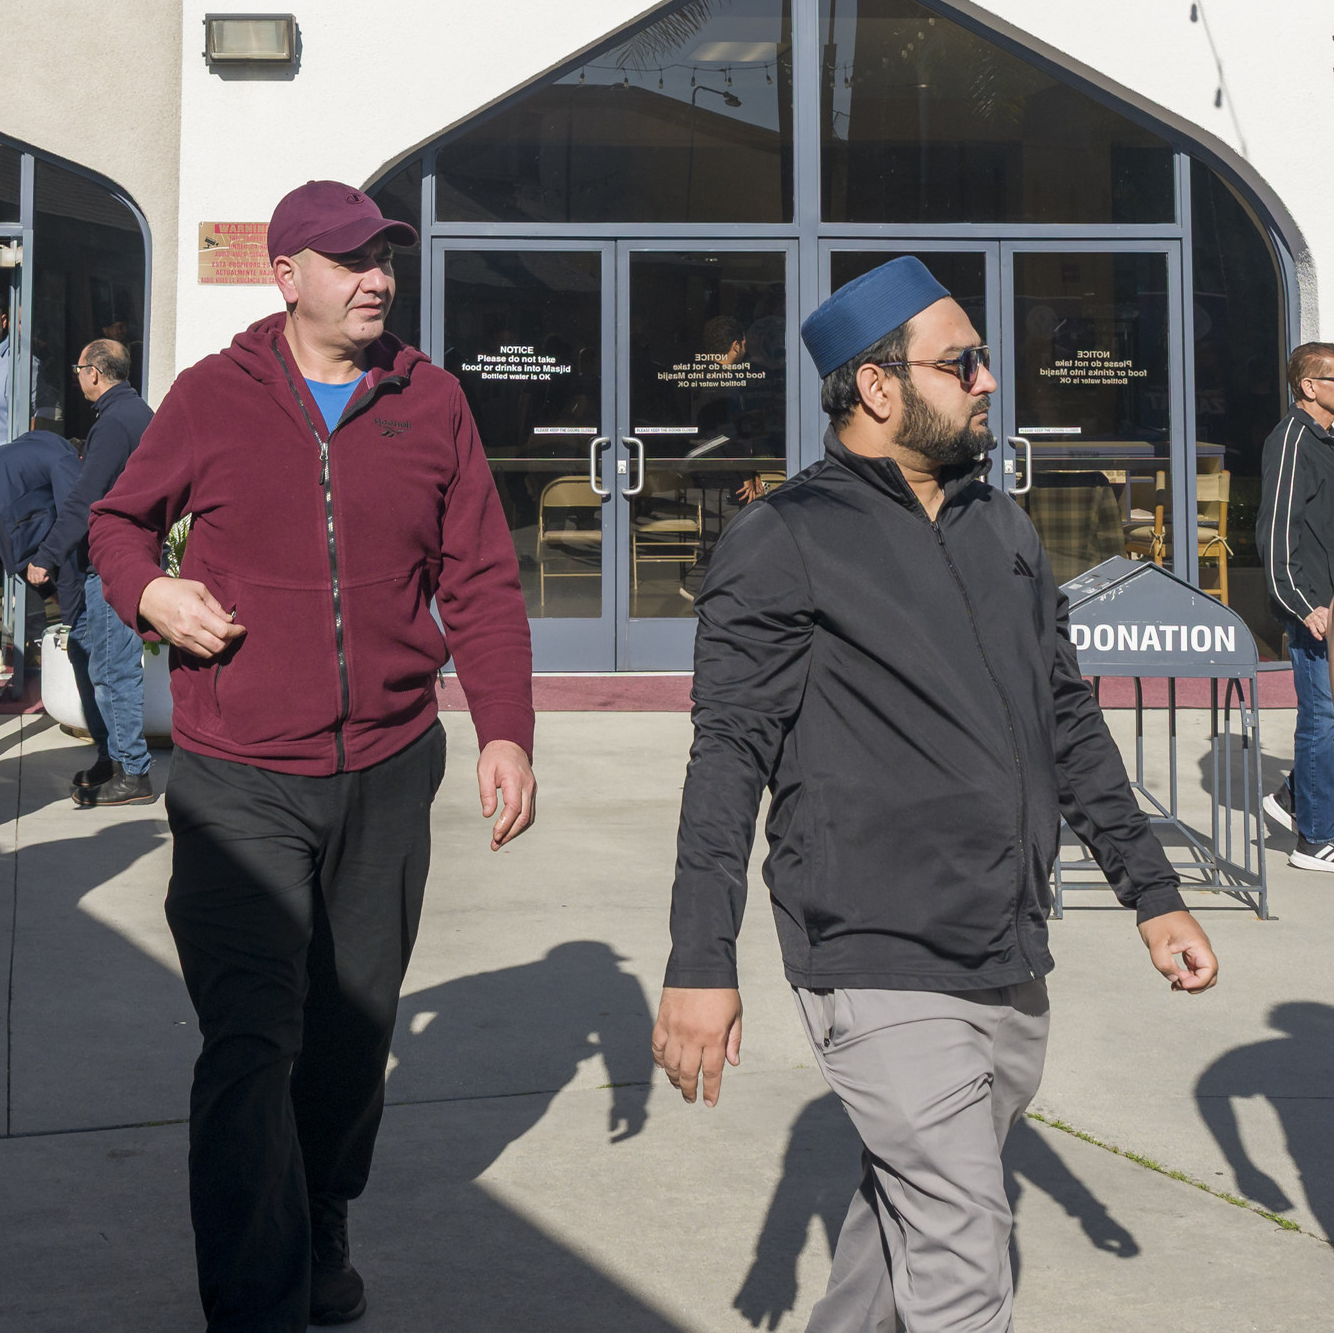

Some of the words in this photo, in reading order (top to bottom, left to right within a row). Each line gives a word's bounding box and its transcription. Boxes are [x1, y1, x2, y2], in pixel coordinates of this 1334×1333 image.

[219, 224, 268, 234] WARNIN
[500, 346, 534, 354] NOTICE
[477, 354, 507, 363] Please
[508, 355, 520, 363] do
[523, 355, 537, 363] not
[538, 355, 556, 364] take
[462, 363, 482, 371] food
[495, 363, 522, 372] drinks
[524, 364, 541, 372] into
[543, 365, 571, 374] Masjid
[1070, 624, 1236, 652] DONATION
